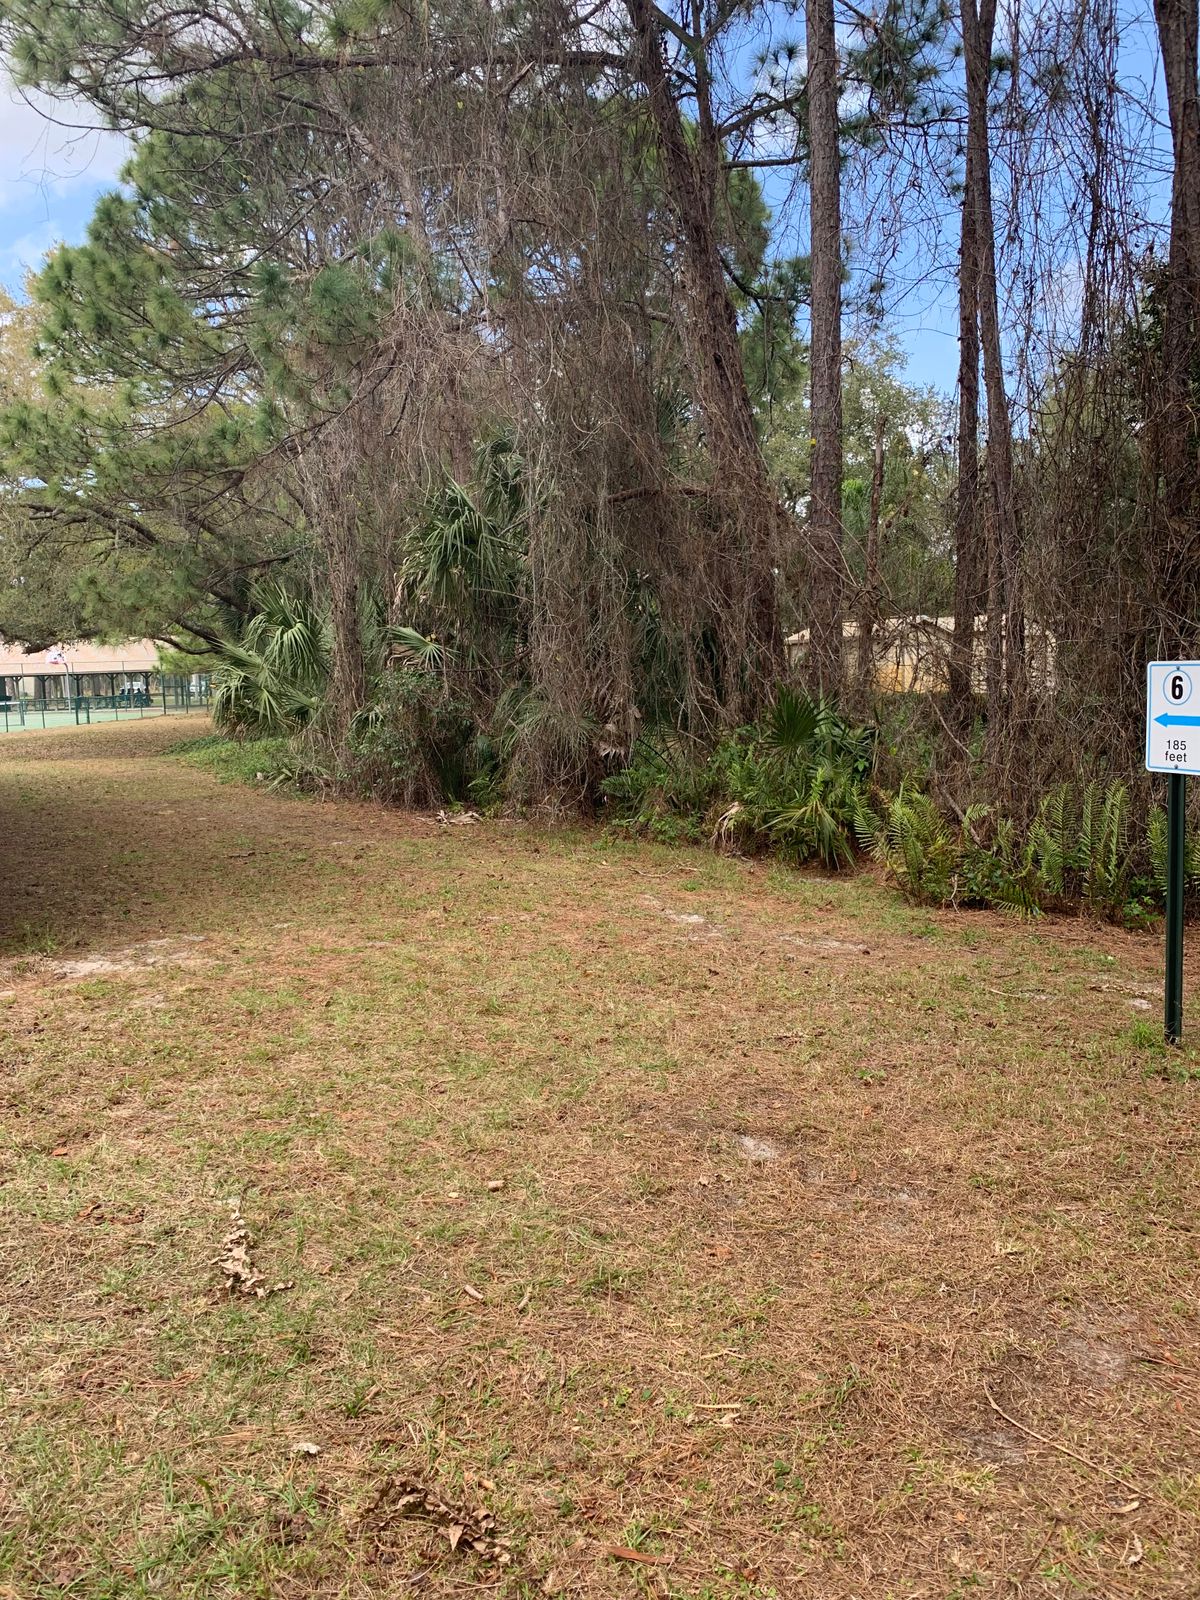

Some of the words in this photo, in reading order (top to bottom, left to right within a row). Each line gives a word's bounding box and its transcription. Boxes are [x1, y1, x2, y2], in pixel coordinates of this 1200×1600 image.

[1171, 675, 1184, 700] 6
[1166, 740, 1187, 750] 185
[1165, 751, 1187, 762] feet
